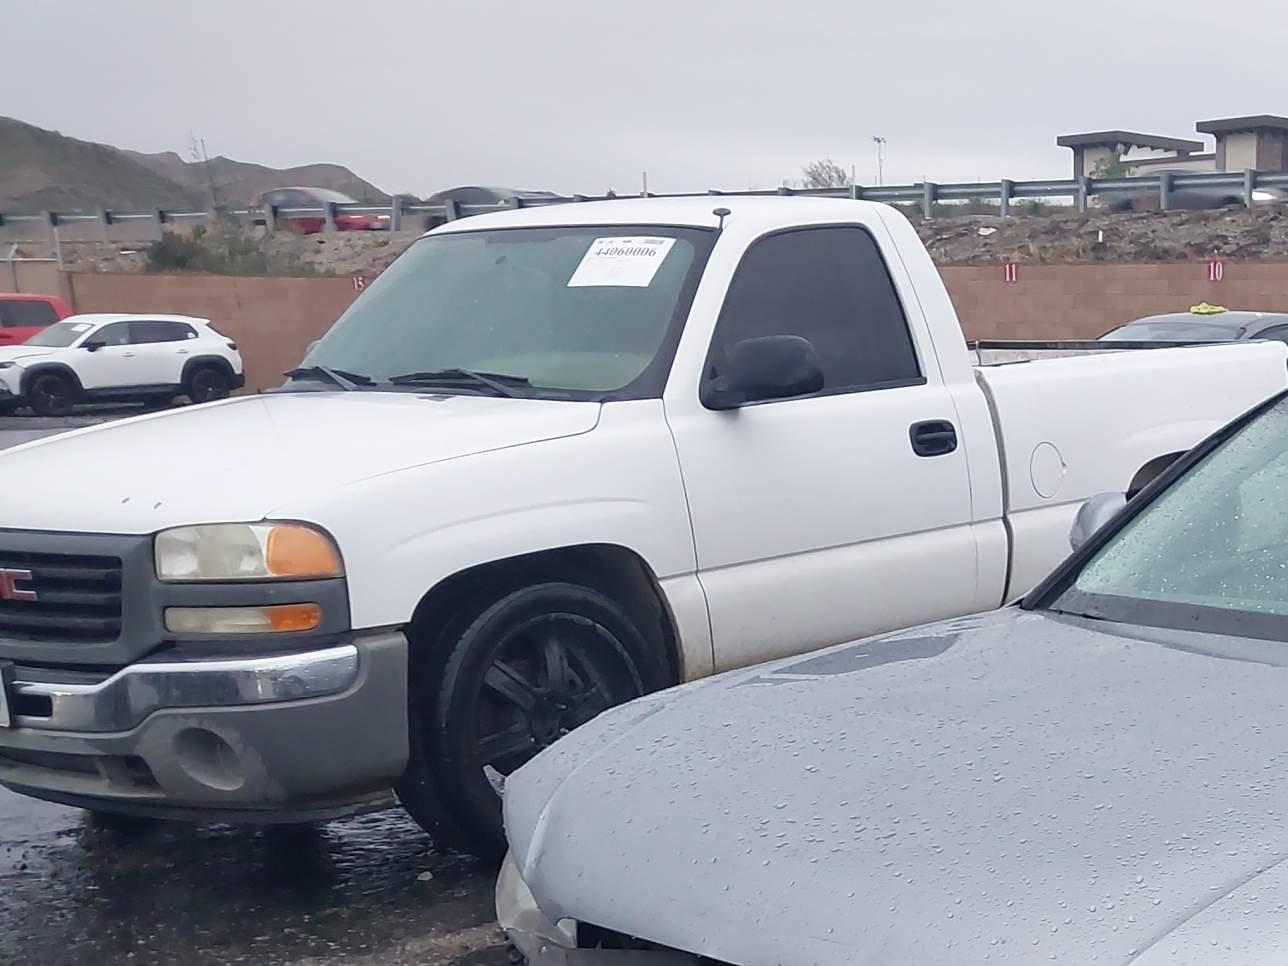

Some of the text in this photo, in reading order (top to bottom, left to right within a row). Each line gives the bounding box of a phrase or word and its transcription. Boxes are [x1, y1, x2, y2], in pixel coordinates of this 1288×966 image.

[595, 247, 657, 257] 44060006
[1005, 263, 1017, 282] 11
[1209, 261, 1223, 281] 10
